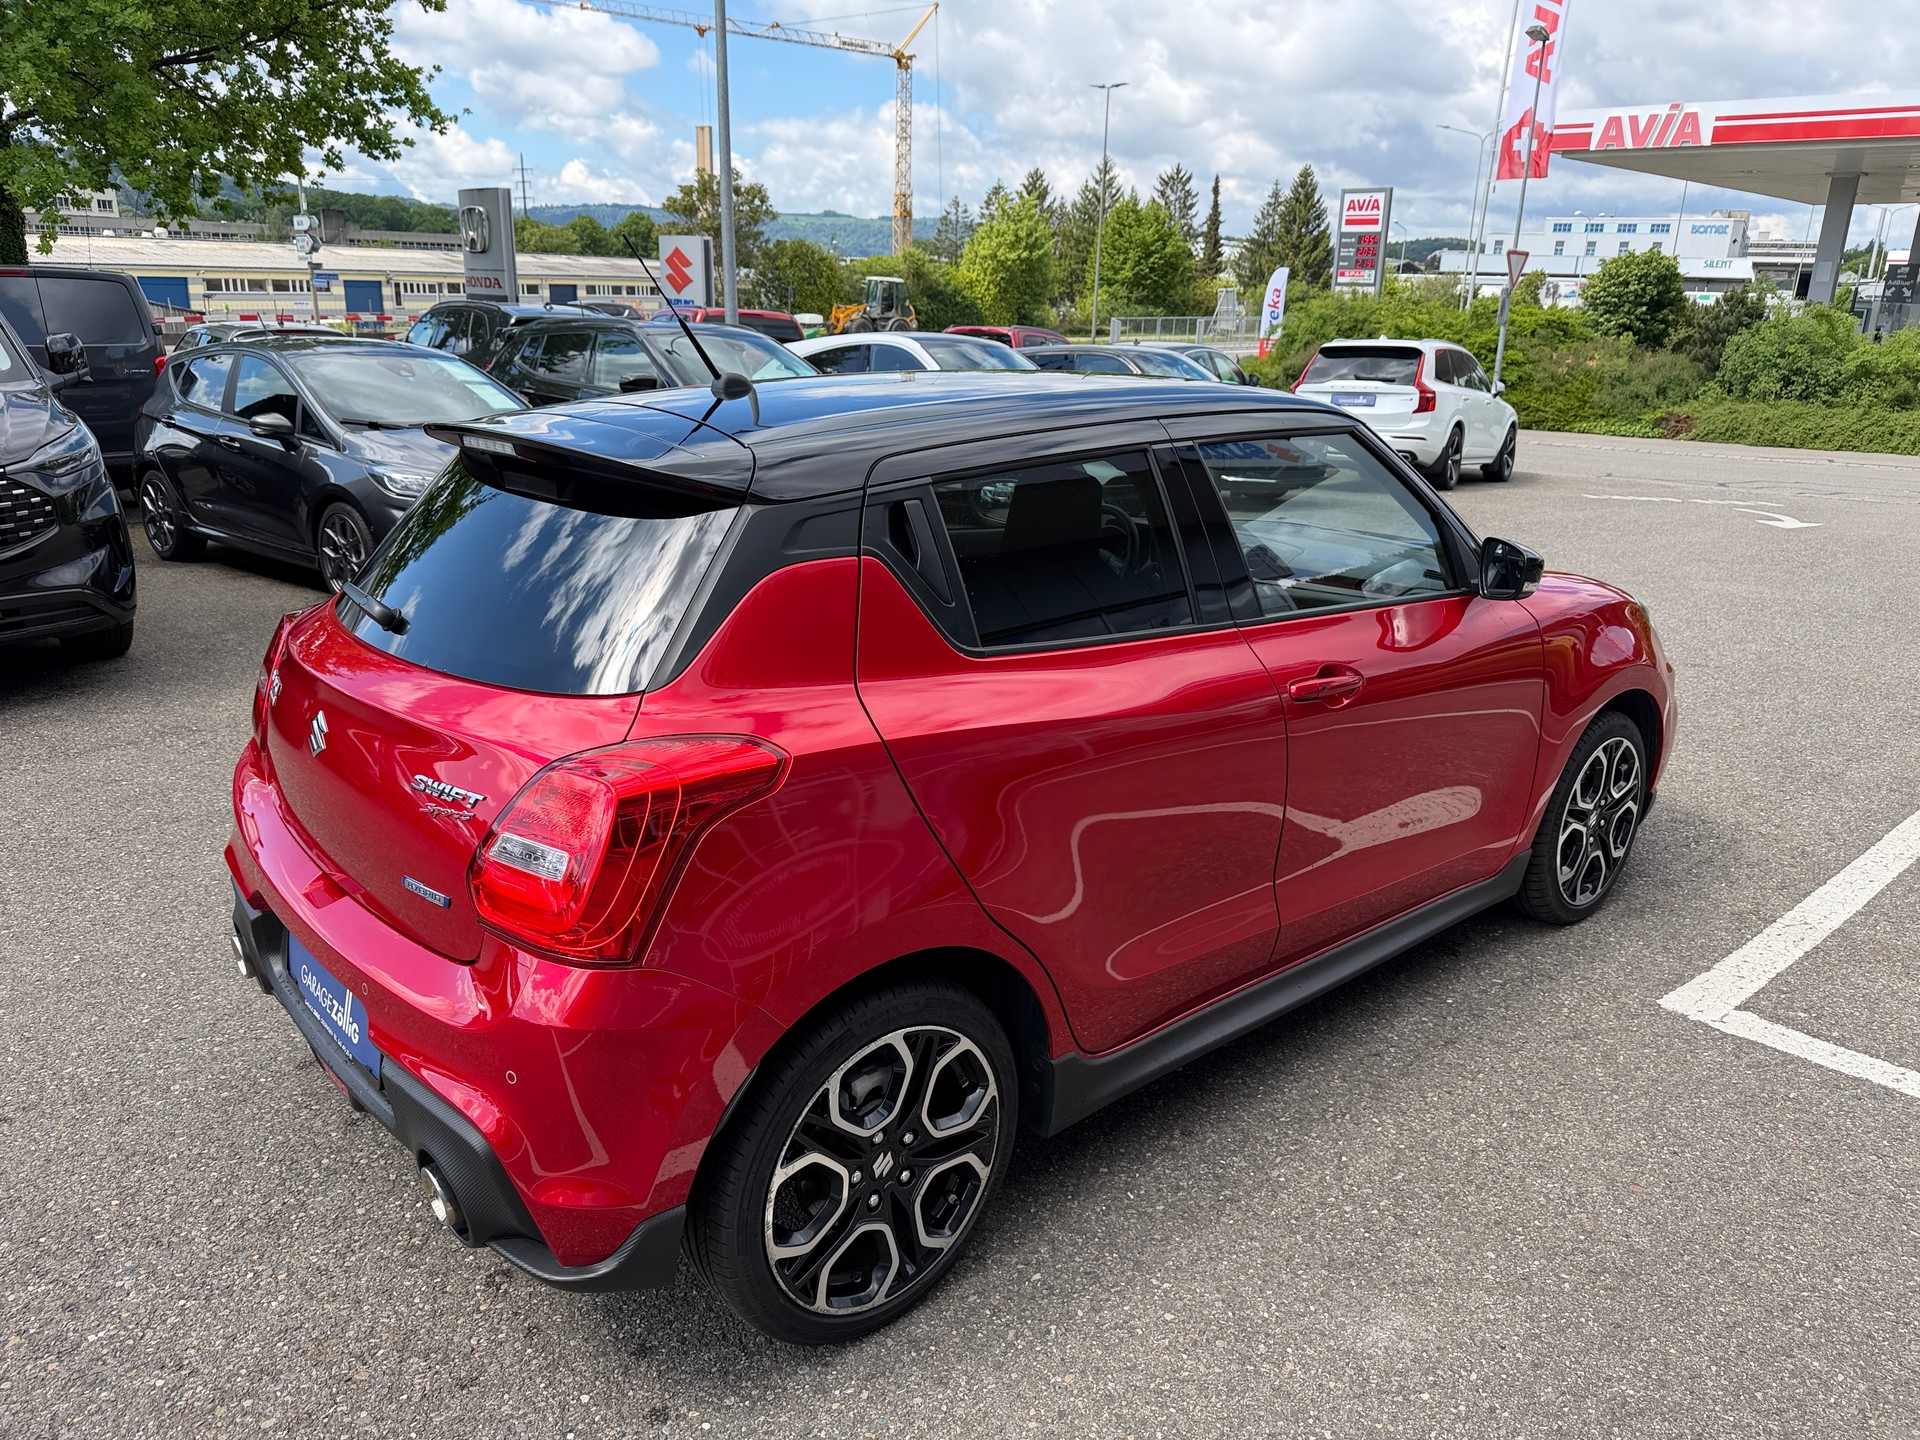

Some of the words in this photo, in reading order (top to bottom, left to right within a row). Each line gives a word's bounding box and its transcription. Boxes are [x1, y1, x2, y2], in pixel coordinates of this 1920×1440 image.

[1595, 103, 1702, 149] AVIA
[1346, 195, 1380, 212] AVIA
[1703, 259, 1734, 269] SILENT
[465, 275, 503, 289] HONDA
[410, 774, 487, 809] SWIFT
